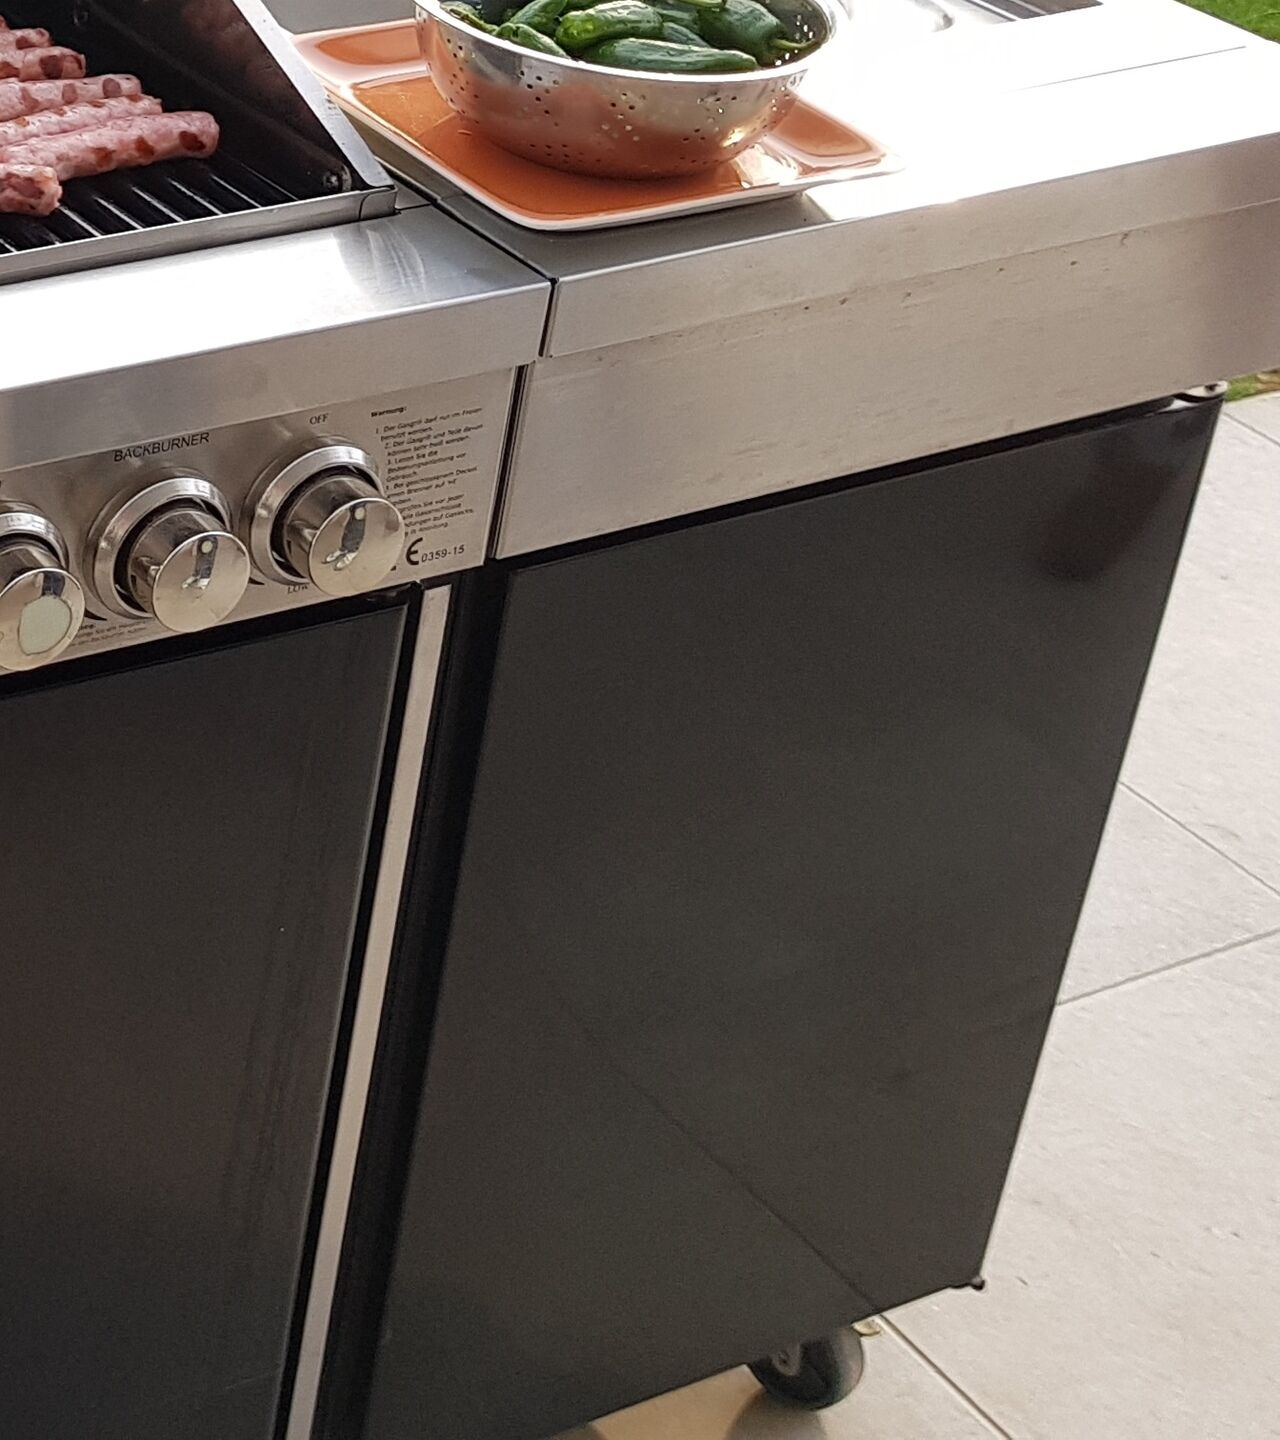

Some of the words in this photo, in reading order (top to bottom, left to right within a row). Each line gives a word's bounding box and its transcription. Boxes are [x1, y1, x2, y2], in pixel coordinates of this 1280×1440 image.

[309, 413, 329, 425] OFF
[113, 431, 210, 462] BACKBURNER
[421, 544, 465, 563] 0359-15
